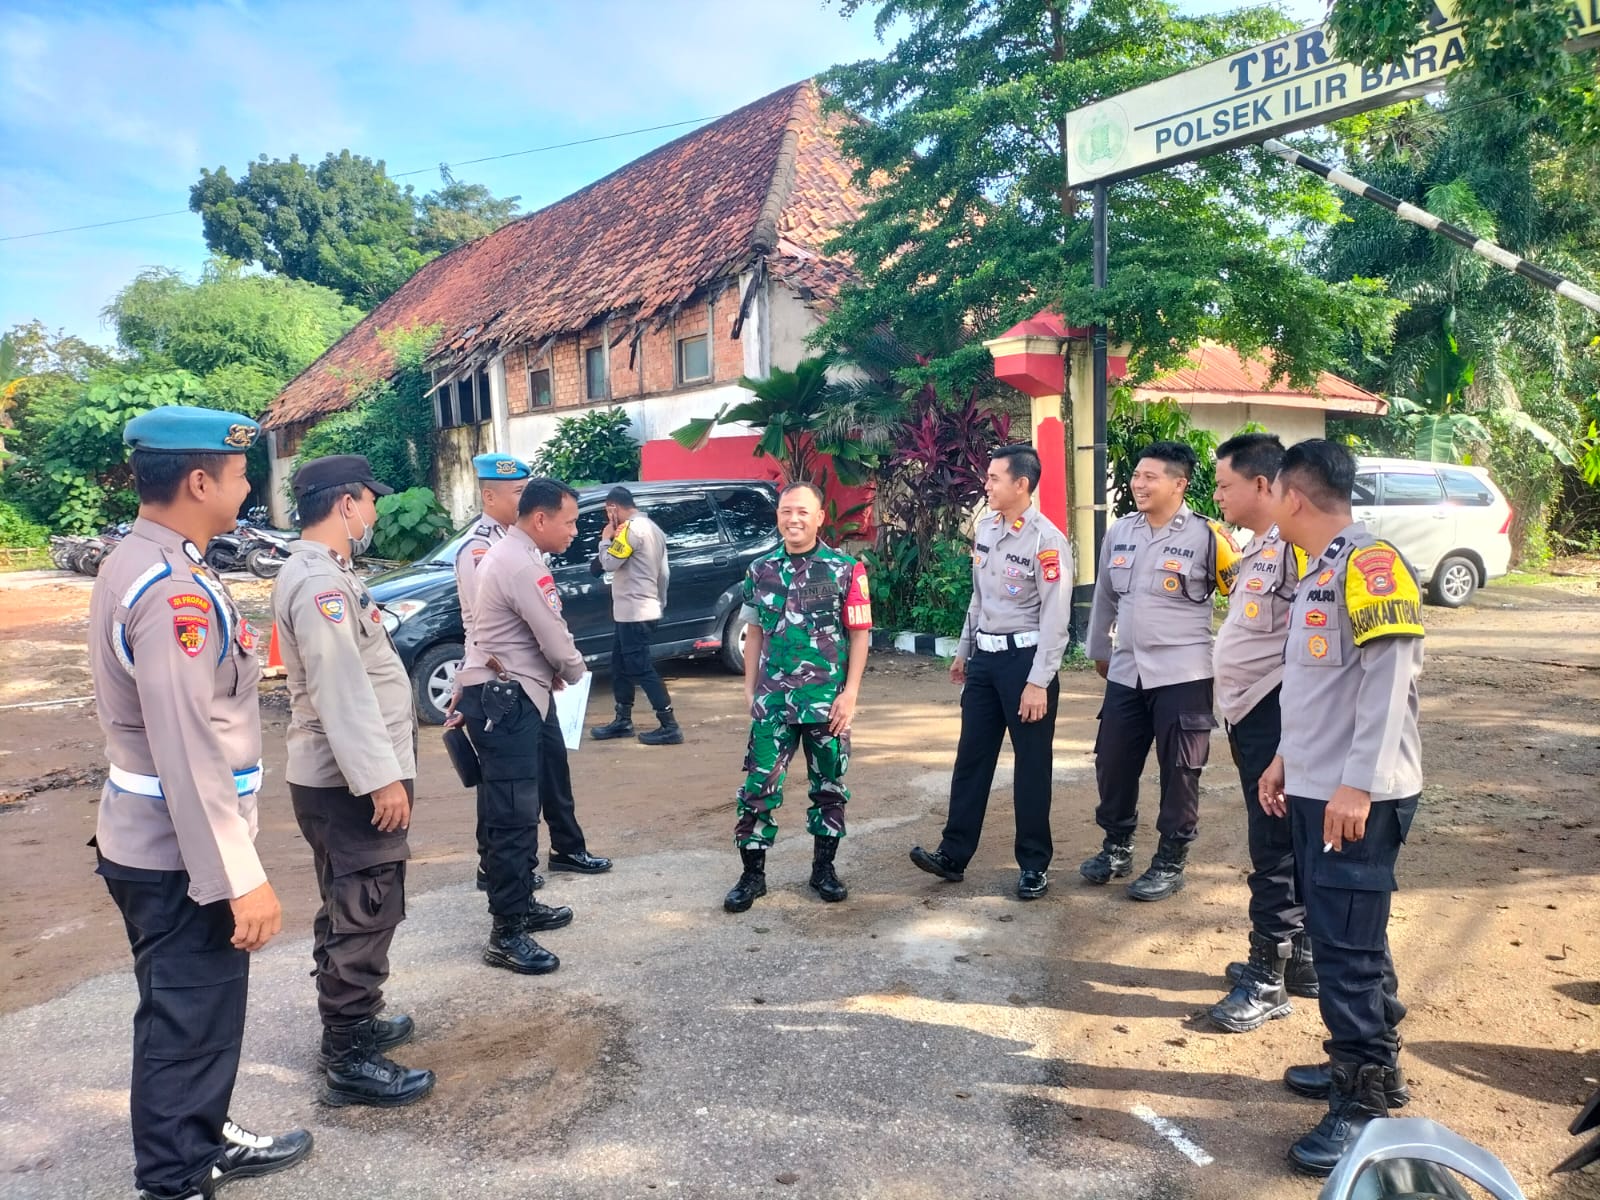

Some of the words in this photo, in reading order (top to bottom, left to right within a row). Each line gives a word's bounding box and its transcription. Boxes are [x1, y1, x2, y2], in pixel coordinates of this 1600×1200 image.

[1156, 95, 1273, 153] POLSEK
[1284, 73, 1347, 116] ILIR
[1361, 36, 1466, 93] BARA
[1163, 546, 1195, 559] POLRI
[1005, 553, 1031, 567] POLRI
[1253, 562, 1277, 574] POLRI
[1306, 589, 1336, 602] POLRI
